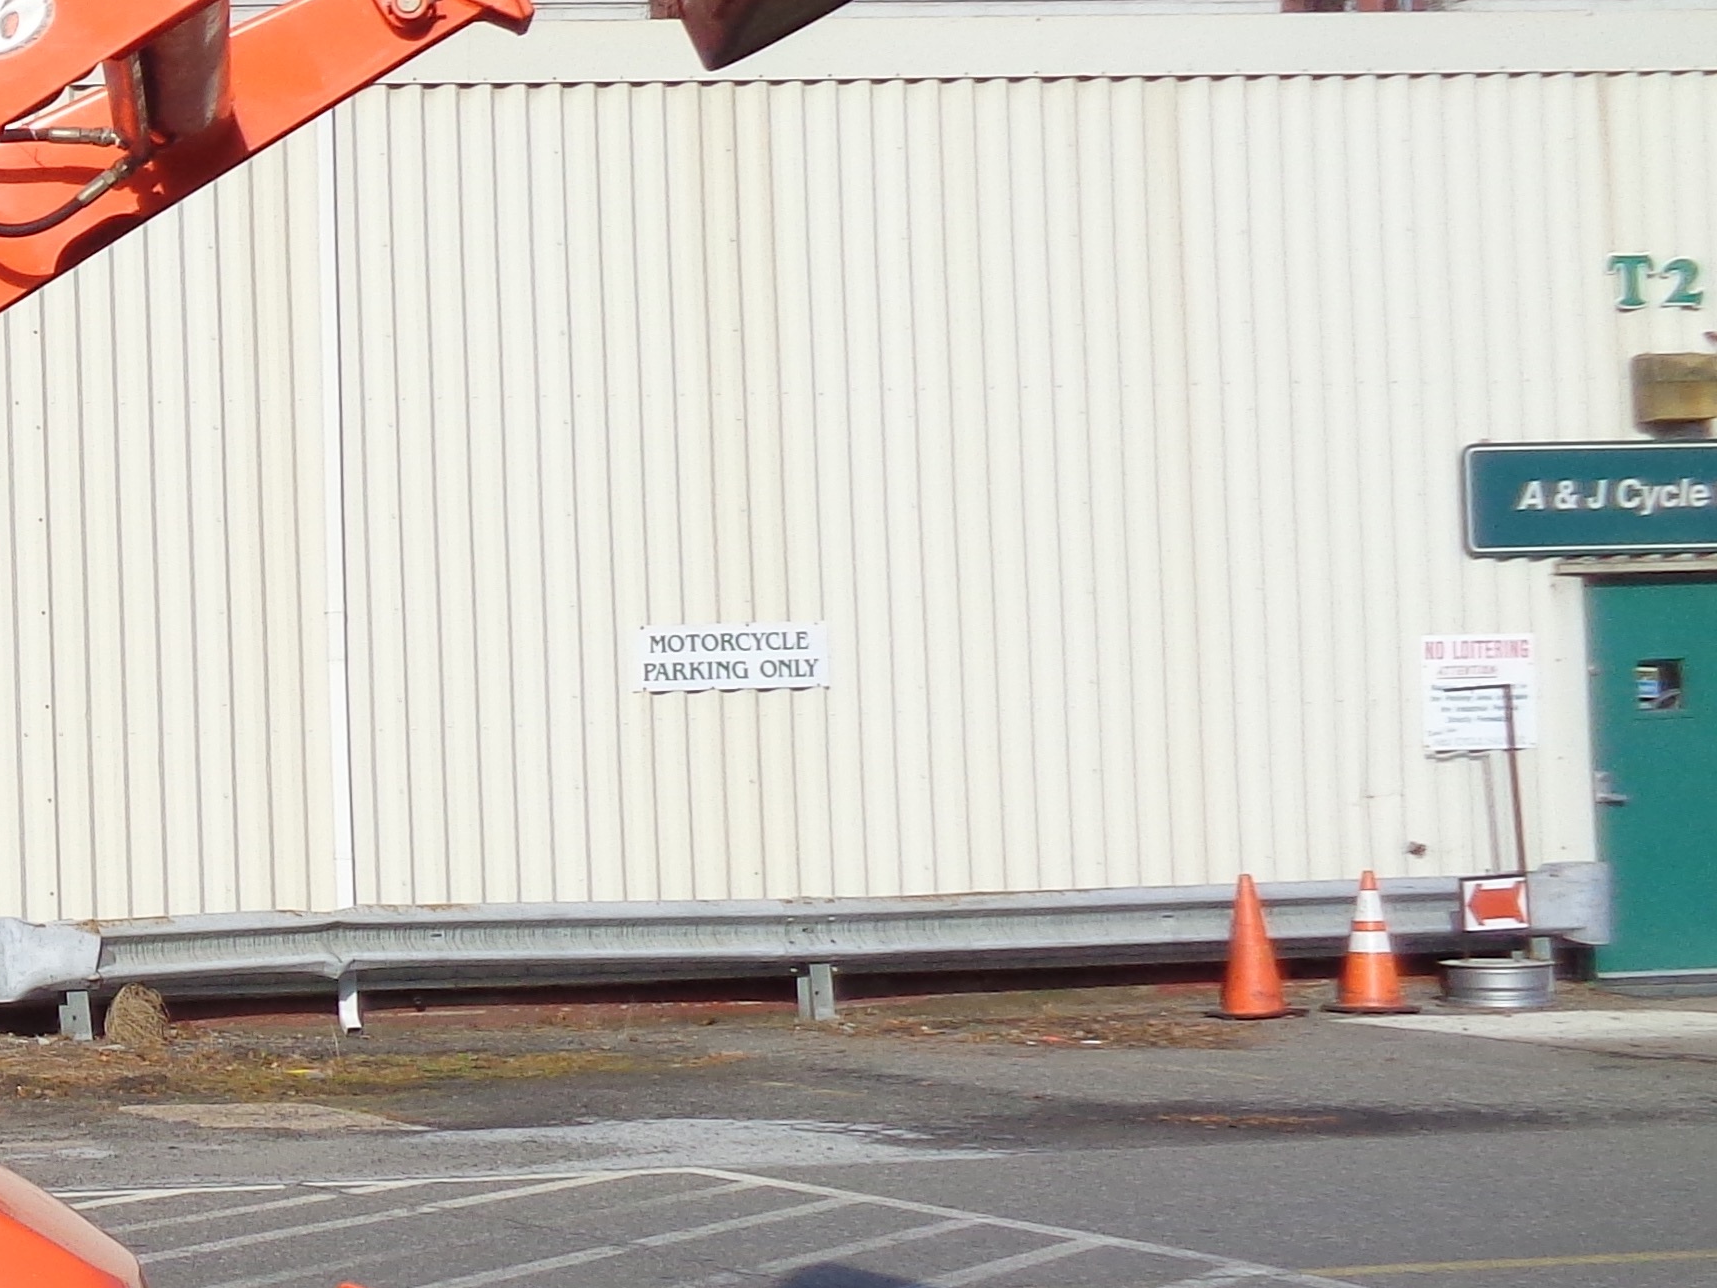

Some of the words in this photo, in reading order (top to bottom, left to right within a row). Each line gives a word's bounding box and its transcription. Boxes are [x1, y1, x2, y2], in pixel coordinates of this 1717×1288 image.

[1607, 253, 1703, 309] T2
[1517, 479, 1545, 511] A
[1554, 479, 1579, 510] &
[1587, 478, 1608, 509] J
[1617, 476, 1711, 516] Cycle
[649, 631, 810, 654] MOTORCYCLE
[1424, 640, 1444, 660] NO
[1452, 639, 1529, 660] LOITERING
[643, 660, 749, 682] PARKING
[759, 658, 819, 679] ONLY
